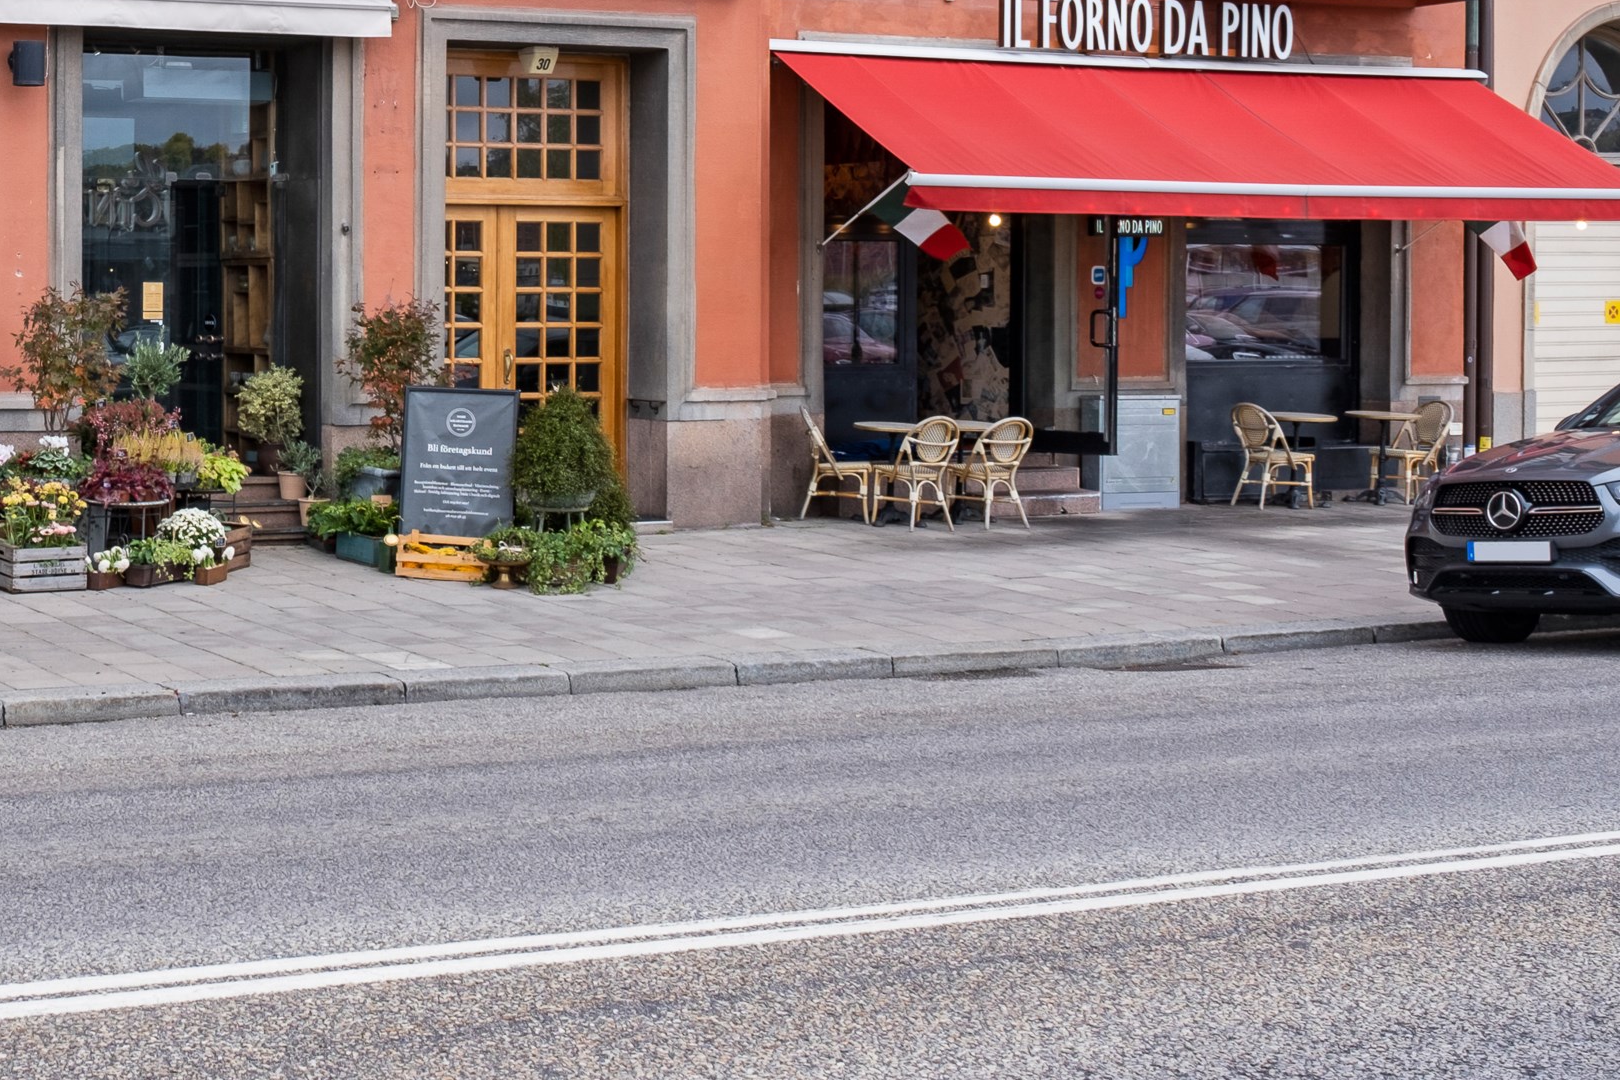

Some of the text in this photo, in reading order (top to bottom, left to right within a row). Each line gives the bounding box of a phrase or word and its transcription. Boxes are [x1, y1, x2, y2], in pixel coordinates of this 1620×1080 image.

[1163, 0, 1208, 56] DA
[1220, 1, 1293, 60] PINO
[536, 58, 551, 70] 30
[1096, 219, 1103, 233] IL
[1132, 219, 1143, 234] DA
[1145, 219, 1163, 234] PINO
[427, 443, 493, 456] Bli företagskund
